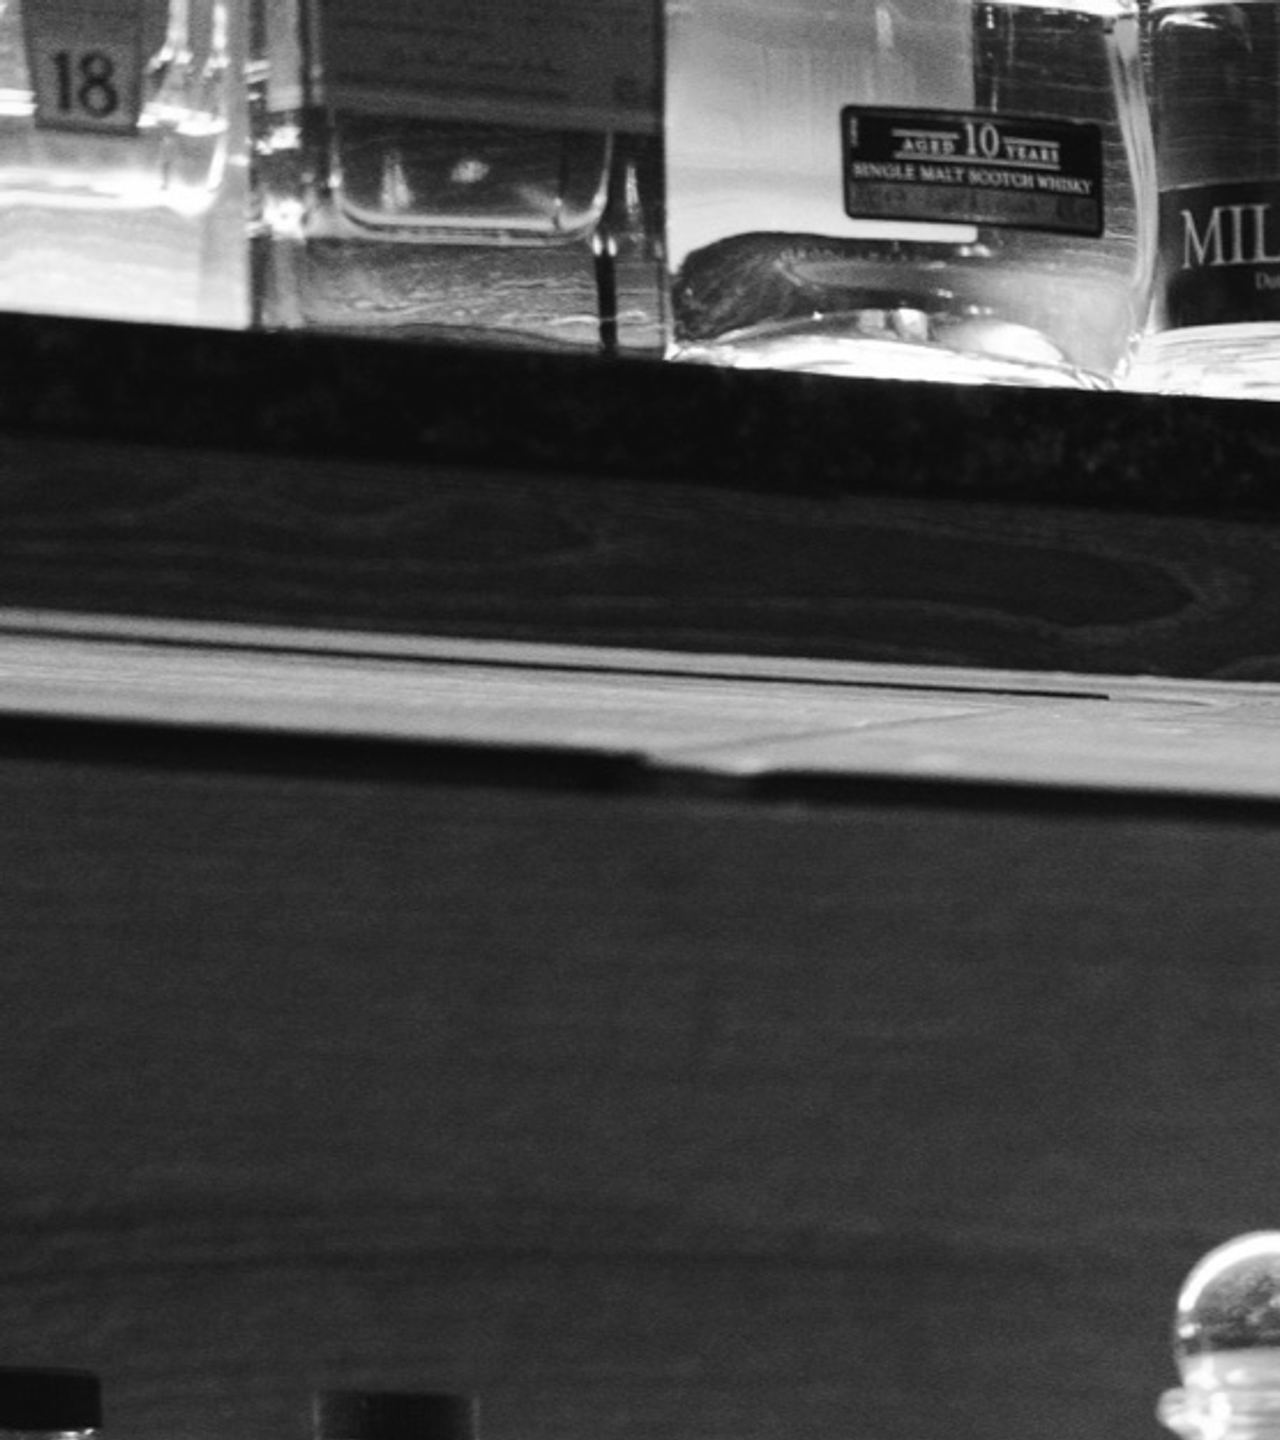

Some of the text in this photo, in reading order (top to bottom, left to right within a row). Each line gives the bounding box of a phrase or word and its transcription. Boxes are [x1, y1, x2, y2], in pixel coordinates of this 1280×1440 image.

[52, 49, 119, 119] 18
[902, 137, 956, 156] AGED
[963, 121, 1000, 157] 10
[853, 161, 1093, 195] SINGLE MALT SCOTCH WHISKY
